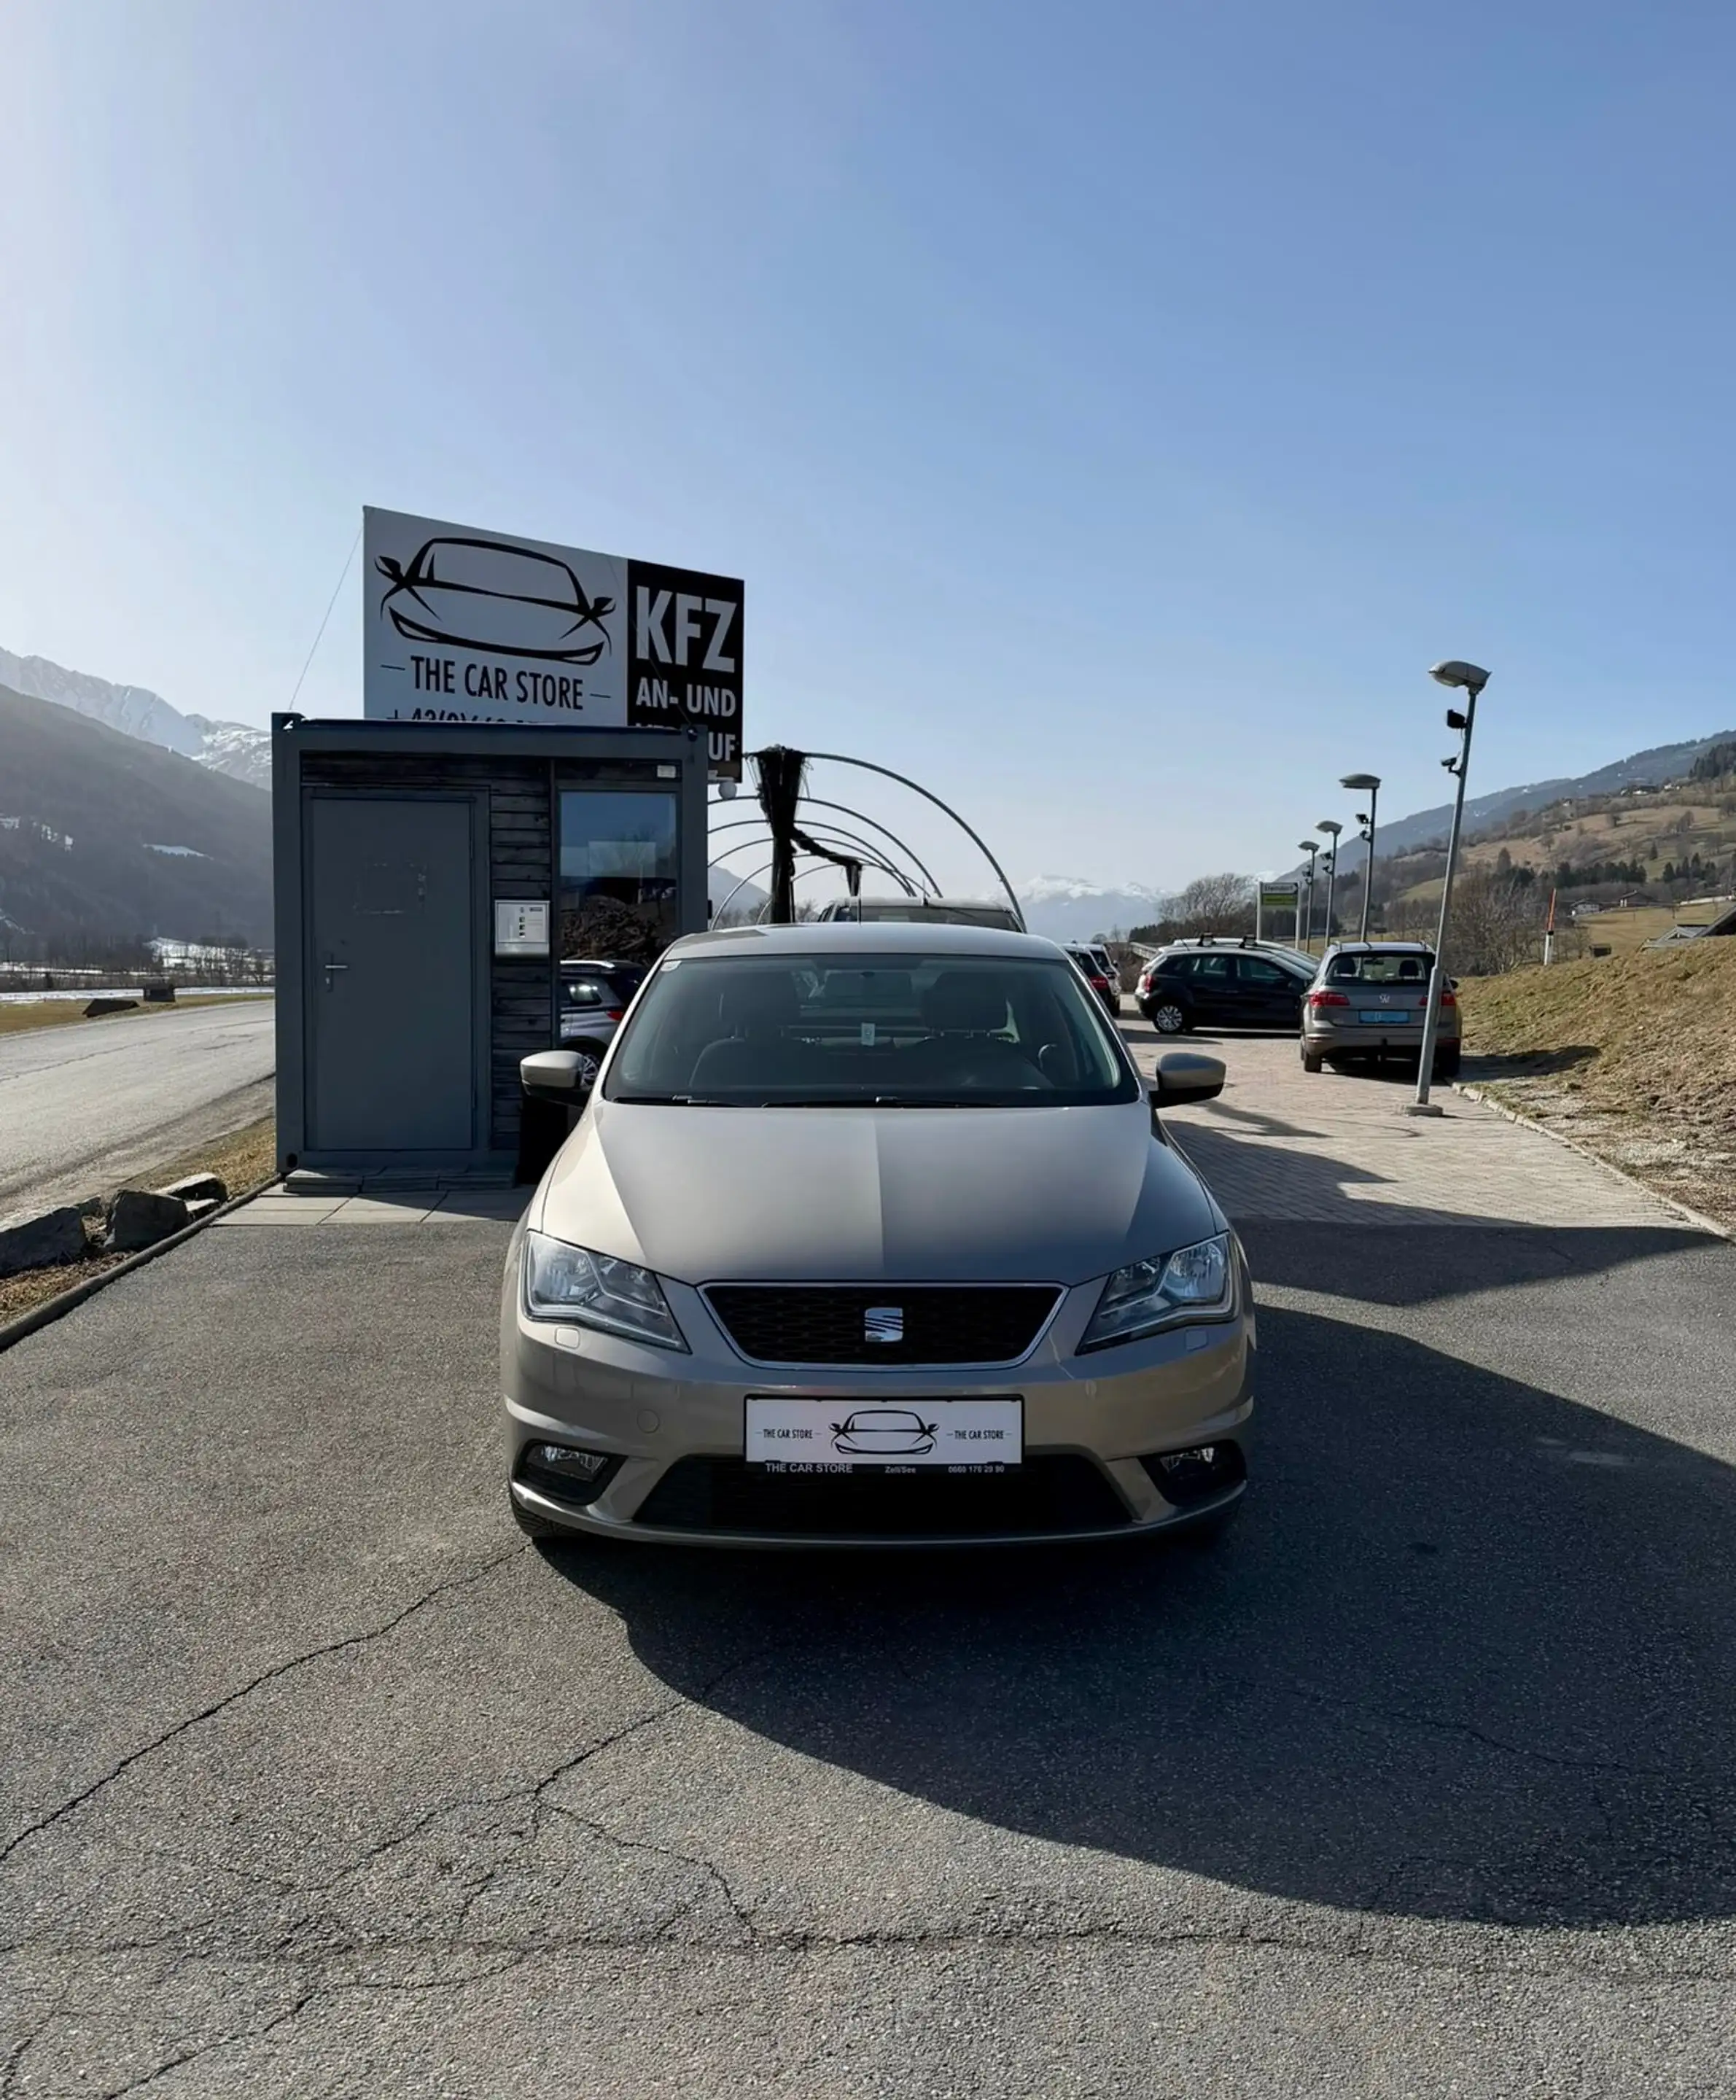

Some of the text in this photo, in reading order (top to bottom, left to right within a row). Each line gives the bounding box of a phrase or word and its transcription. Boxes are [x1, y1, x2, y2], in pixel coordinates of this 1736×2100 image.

[637, 586, 737, 673] KFZ
[410, 655, 583, 710] THE CAR STORE
[636, 677, 736, 717] AN- UND
[763, 1428, 813, 1439] THE CAR STORE
[954, 1430, 1004, 1439] THE CAR STORE
[766, 1463, 787, 1472] THE
[789, 1463, 814, 1472] CAR
[816, 1463, 853, 1473] STORE
